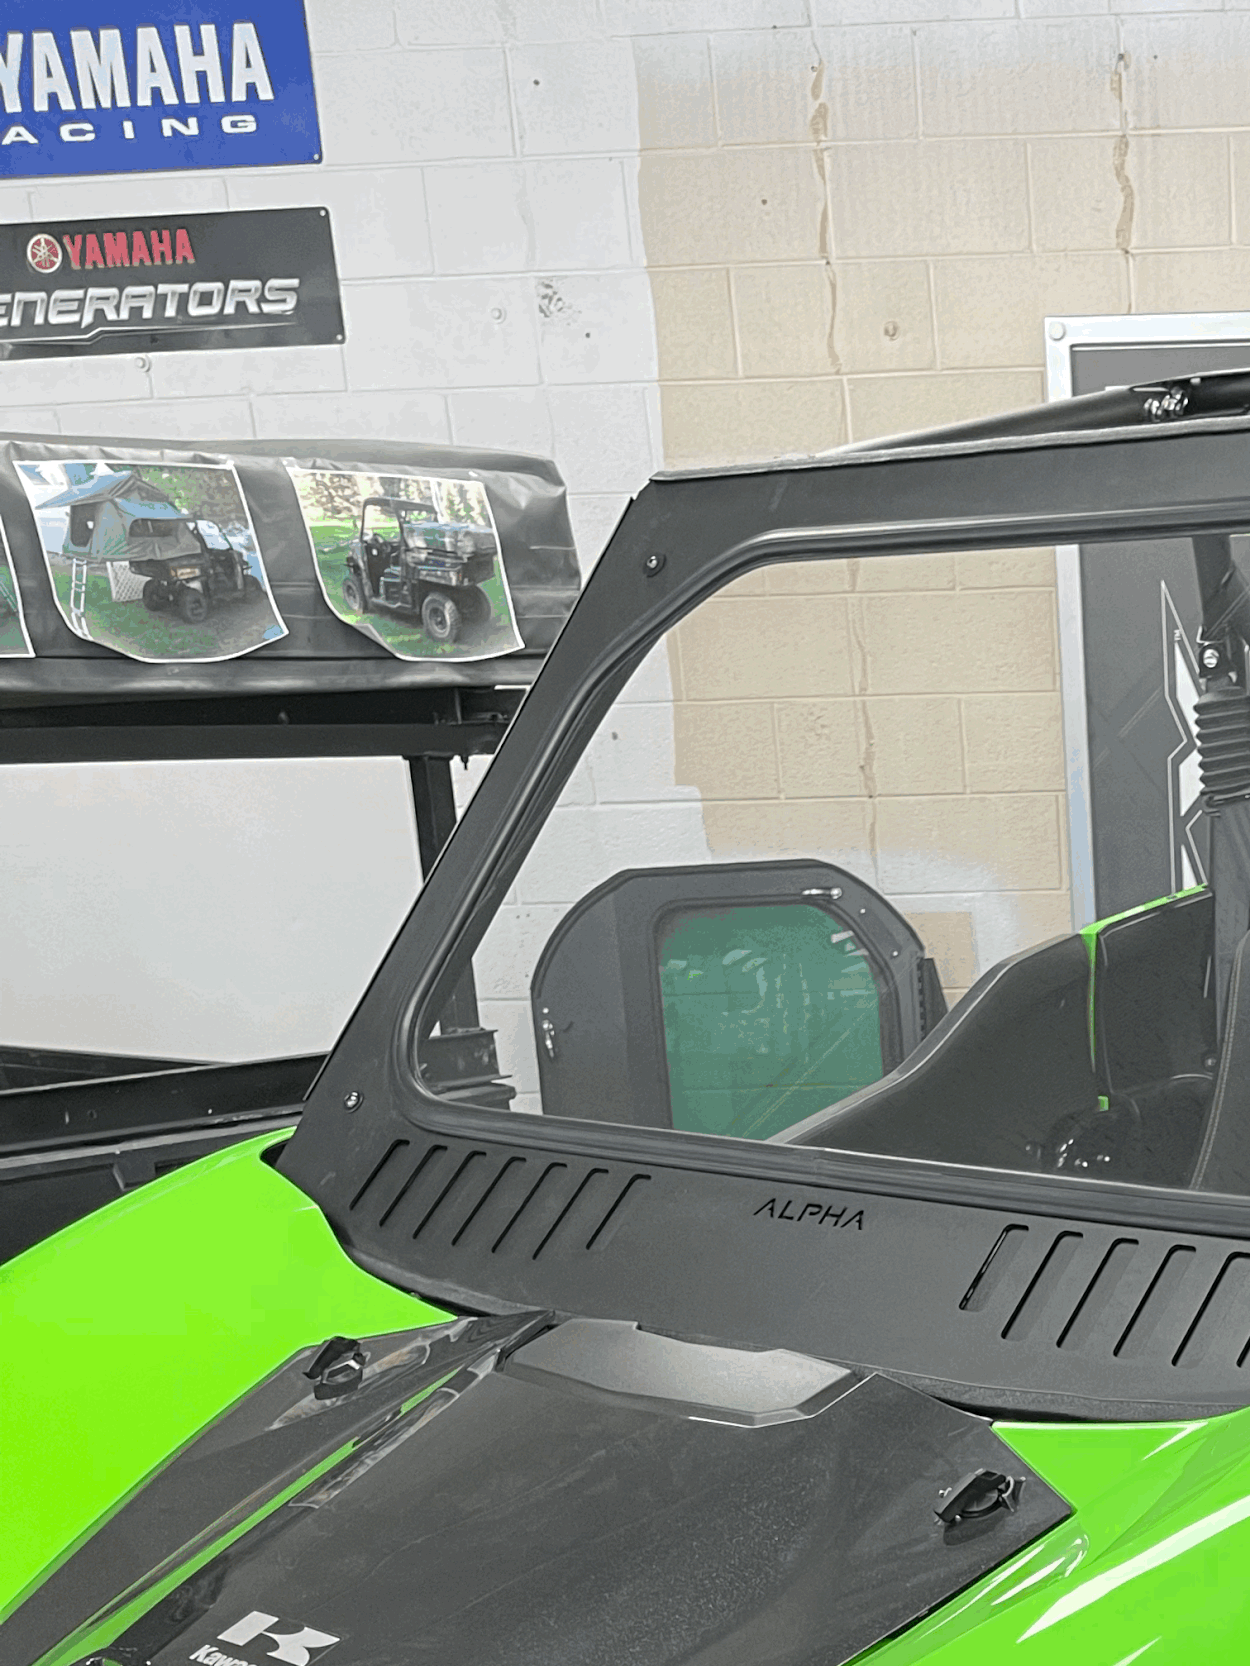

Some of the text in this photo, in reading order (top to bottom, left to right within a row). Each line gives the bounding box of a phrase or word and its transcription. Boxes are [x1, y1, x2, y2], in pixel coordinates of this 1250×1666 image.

[0, 23, 274, 113] YAMAHA
[0, 115, 257, 145] ACING
[62, 229, 195, 269] YAMAHA
[0, 278, 299, 328] NERATORS
[753, 1198, 864, 1230] ALPHA
